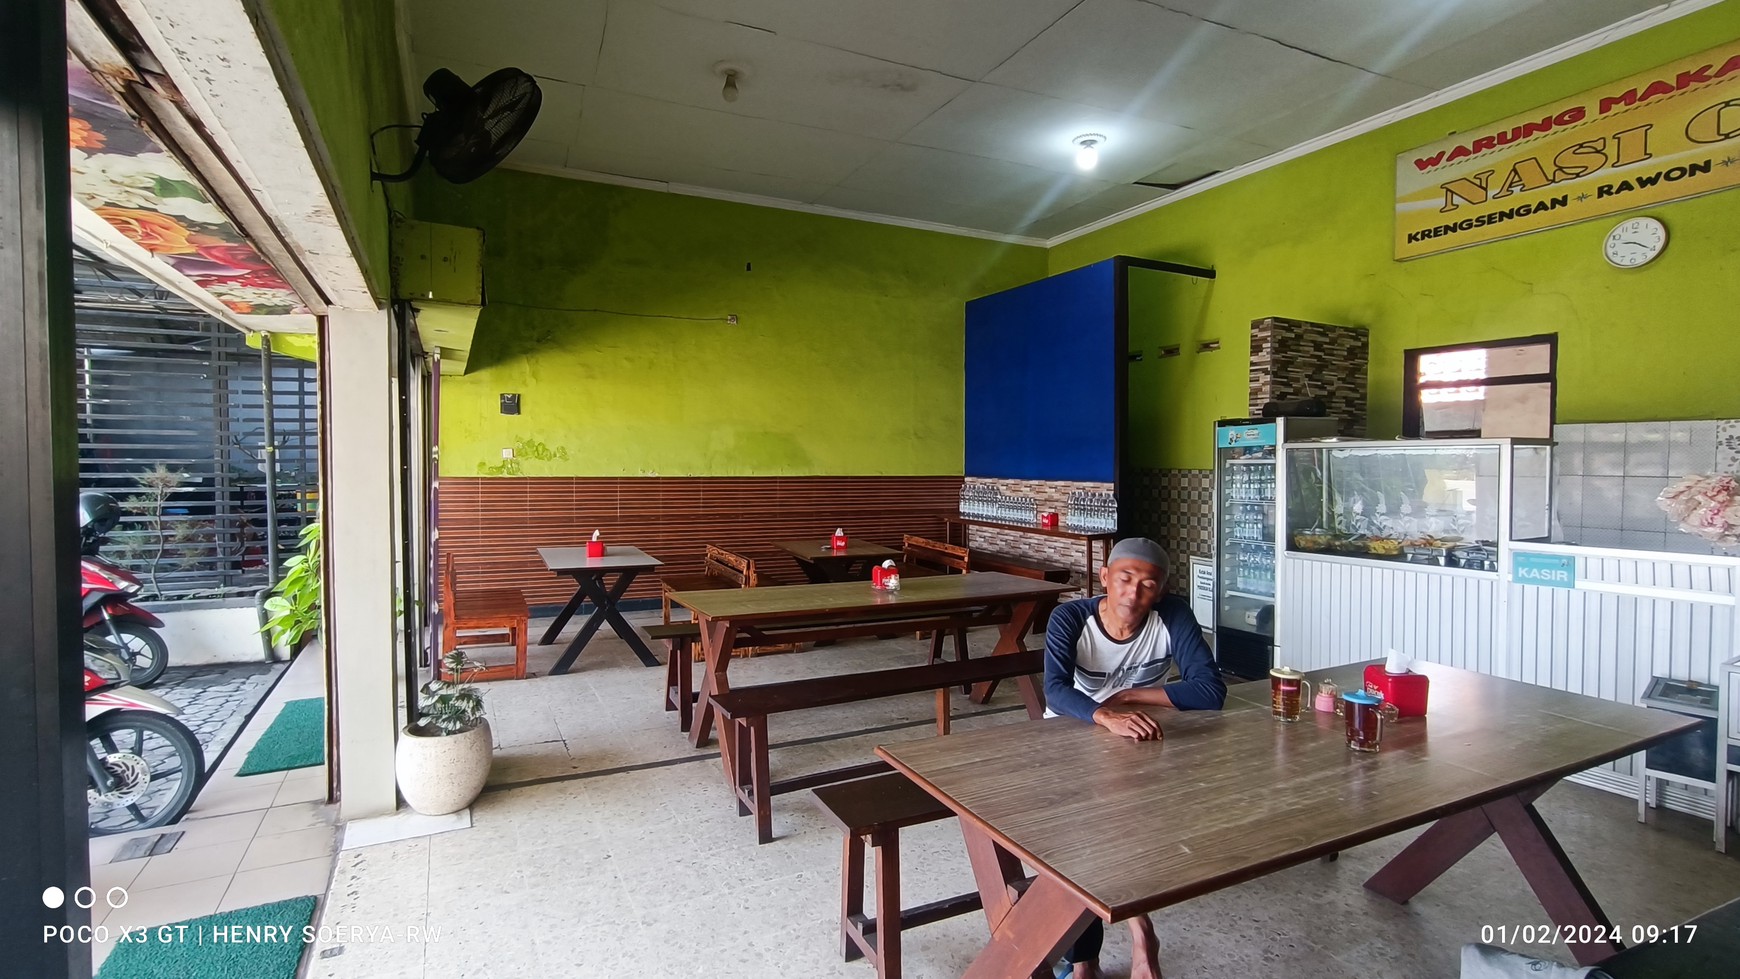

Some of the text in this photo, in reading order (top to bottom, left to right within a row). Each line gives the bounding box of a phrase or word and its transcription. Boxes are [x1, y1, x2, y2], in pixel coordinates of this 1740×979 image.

[1414, 106, 1586, 171] WARUNG
[1440, 124, 1653, 213] NASI
[1407, 159, 1712, 244] KRENGSENGAN RAWON
[1518, 567, 1569, 582] KASIR
